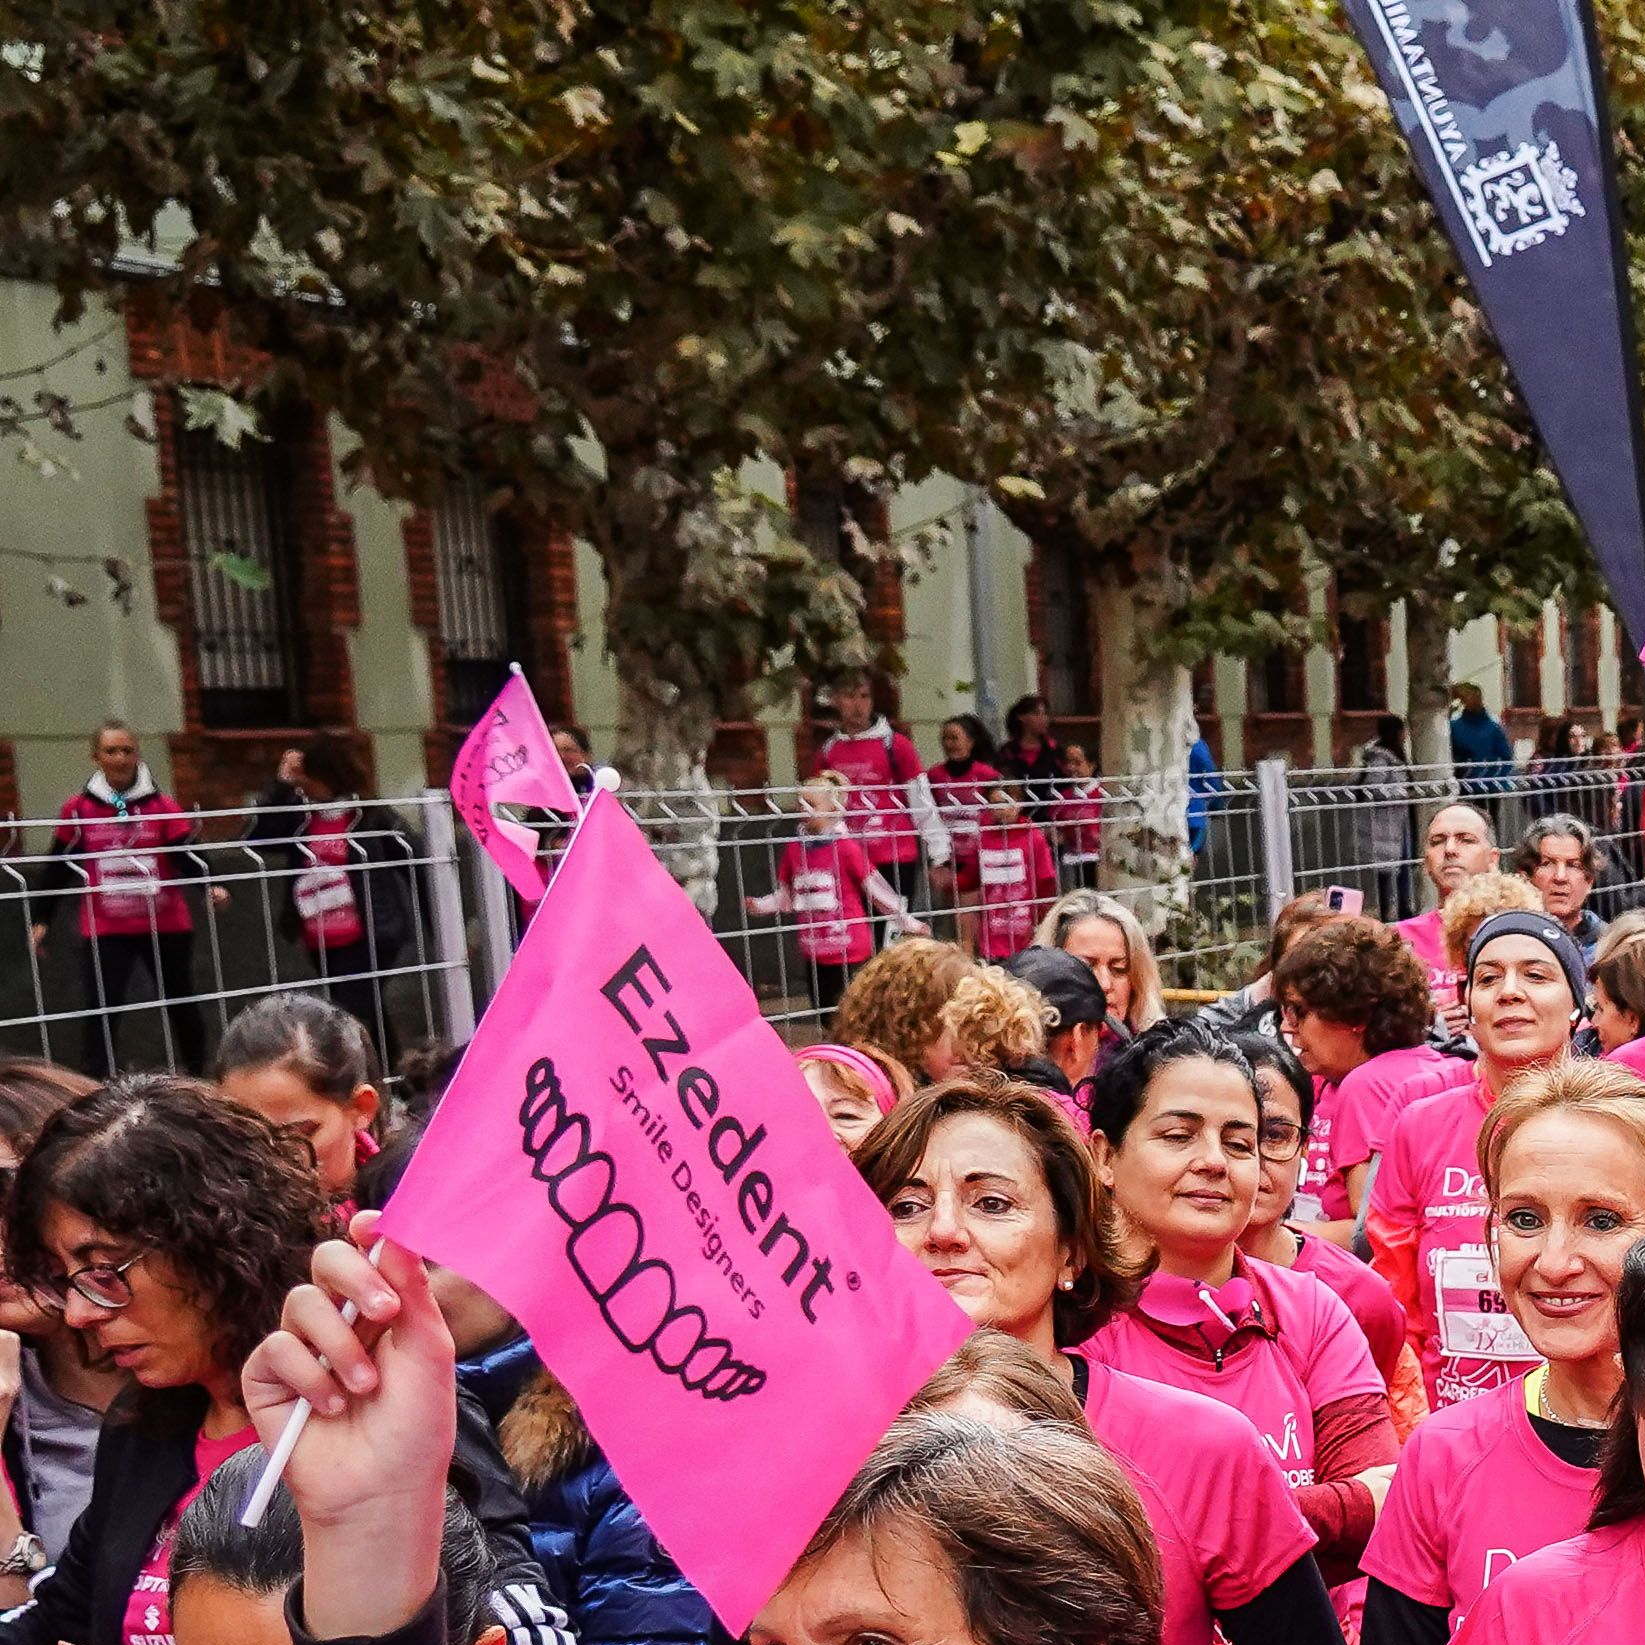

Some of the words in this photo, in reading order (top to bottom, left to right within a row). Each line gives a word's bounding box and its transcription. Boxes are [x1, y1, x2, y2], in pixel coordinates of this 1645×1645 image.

[600, 943, 835, 1324] Ezedent
[609, 1064, 673, 1164] Smile
[671, 1160, 766, 1320] Designers
